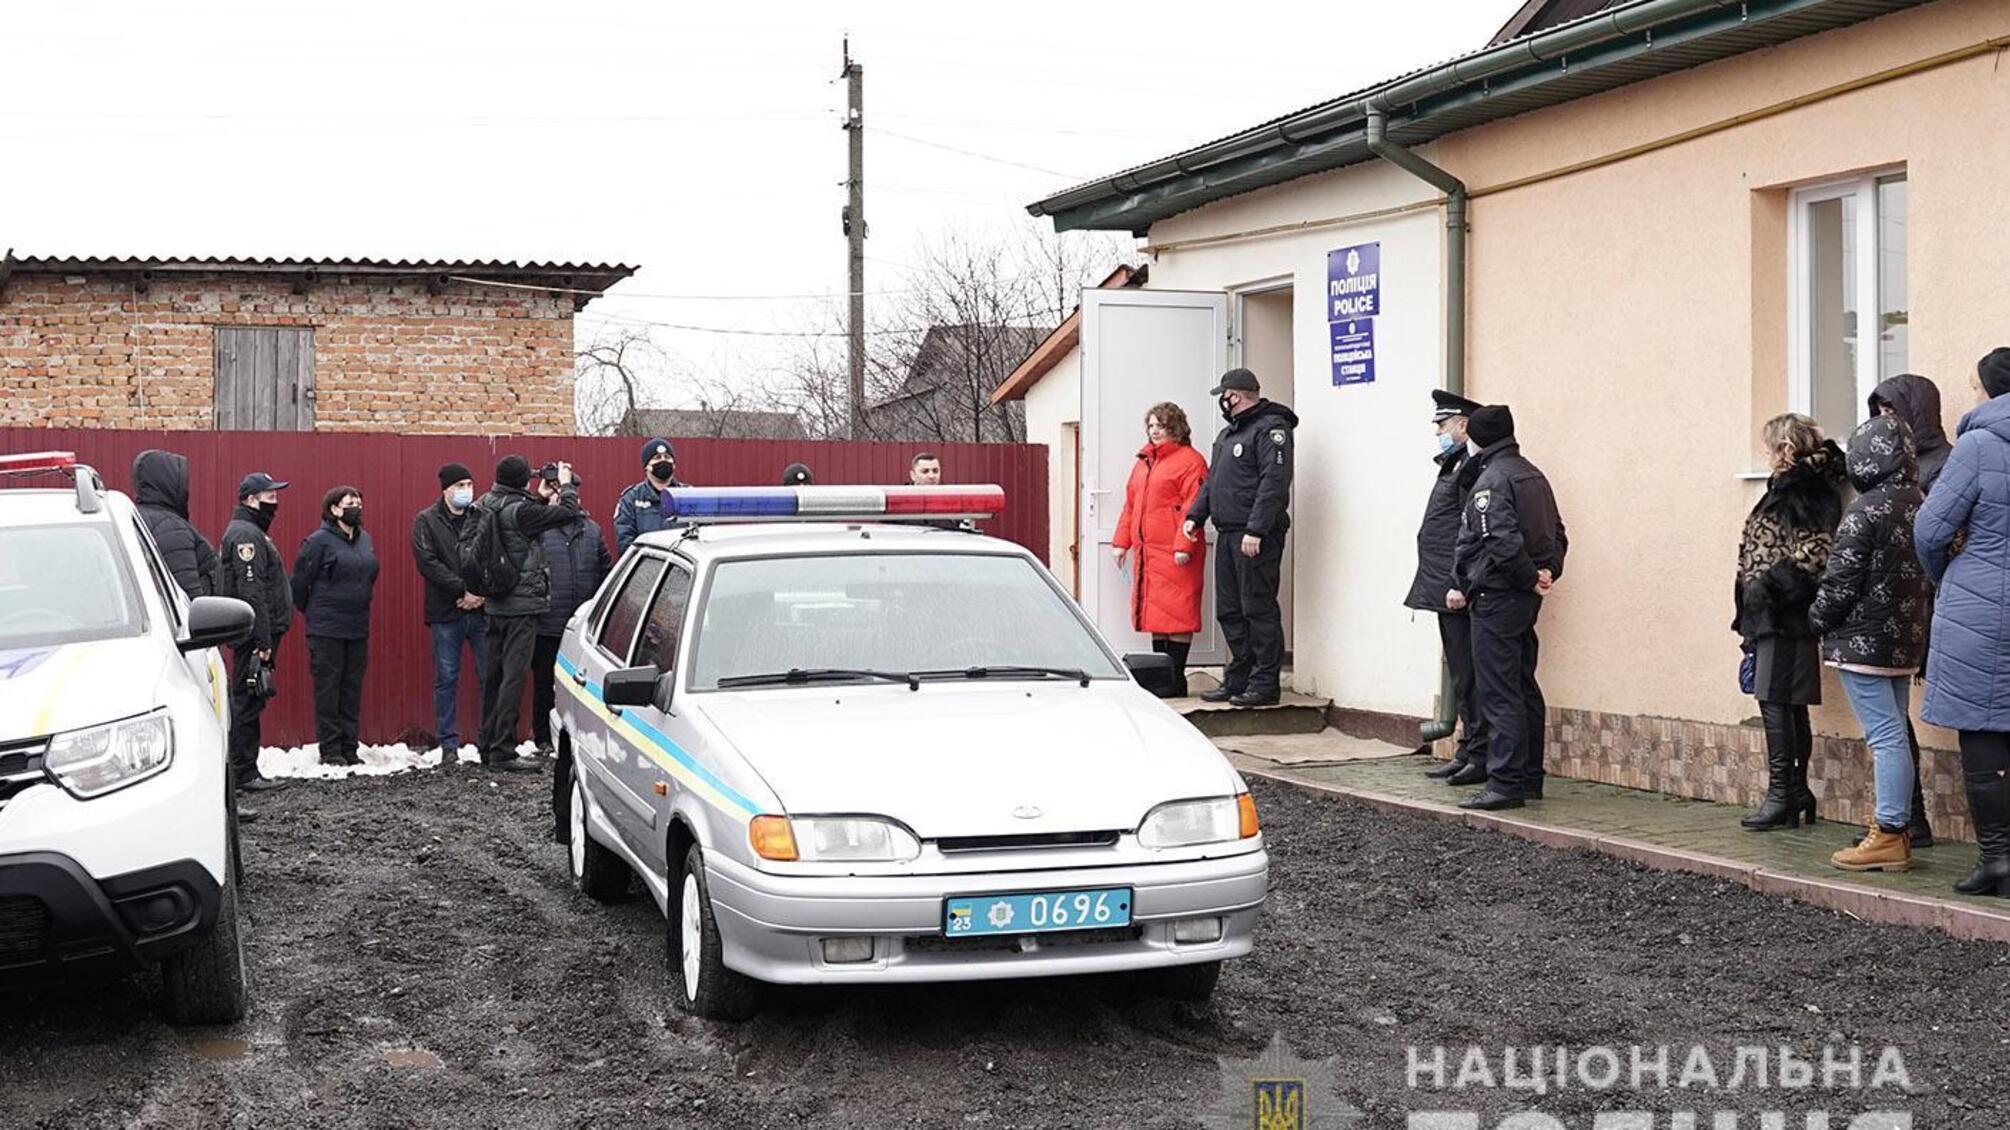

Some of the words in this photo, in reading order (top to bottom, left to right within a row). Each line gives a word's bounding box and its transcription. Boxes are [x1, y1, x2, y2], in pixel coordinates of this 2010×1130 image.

[1331, 273, 1377, 296] ПОЛІЦІЯ
[1334, 295, 1374, 316] POLICE
[1031, 893, 1111, 926] 0696
[952, 917, 972, 931] 23
